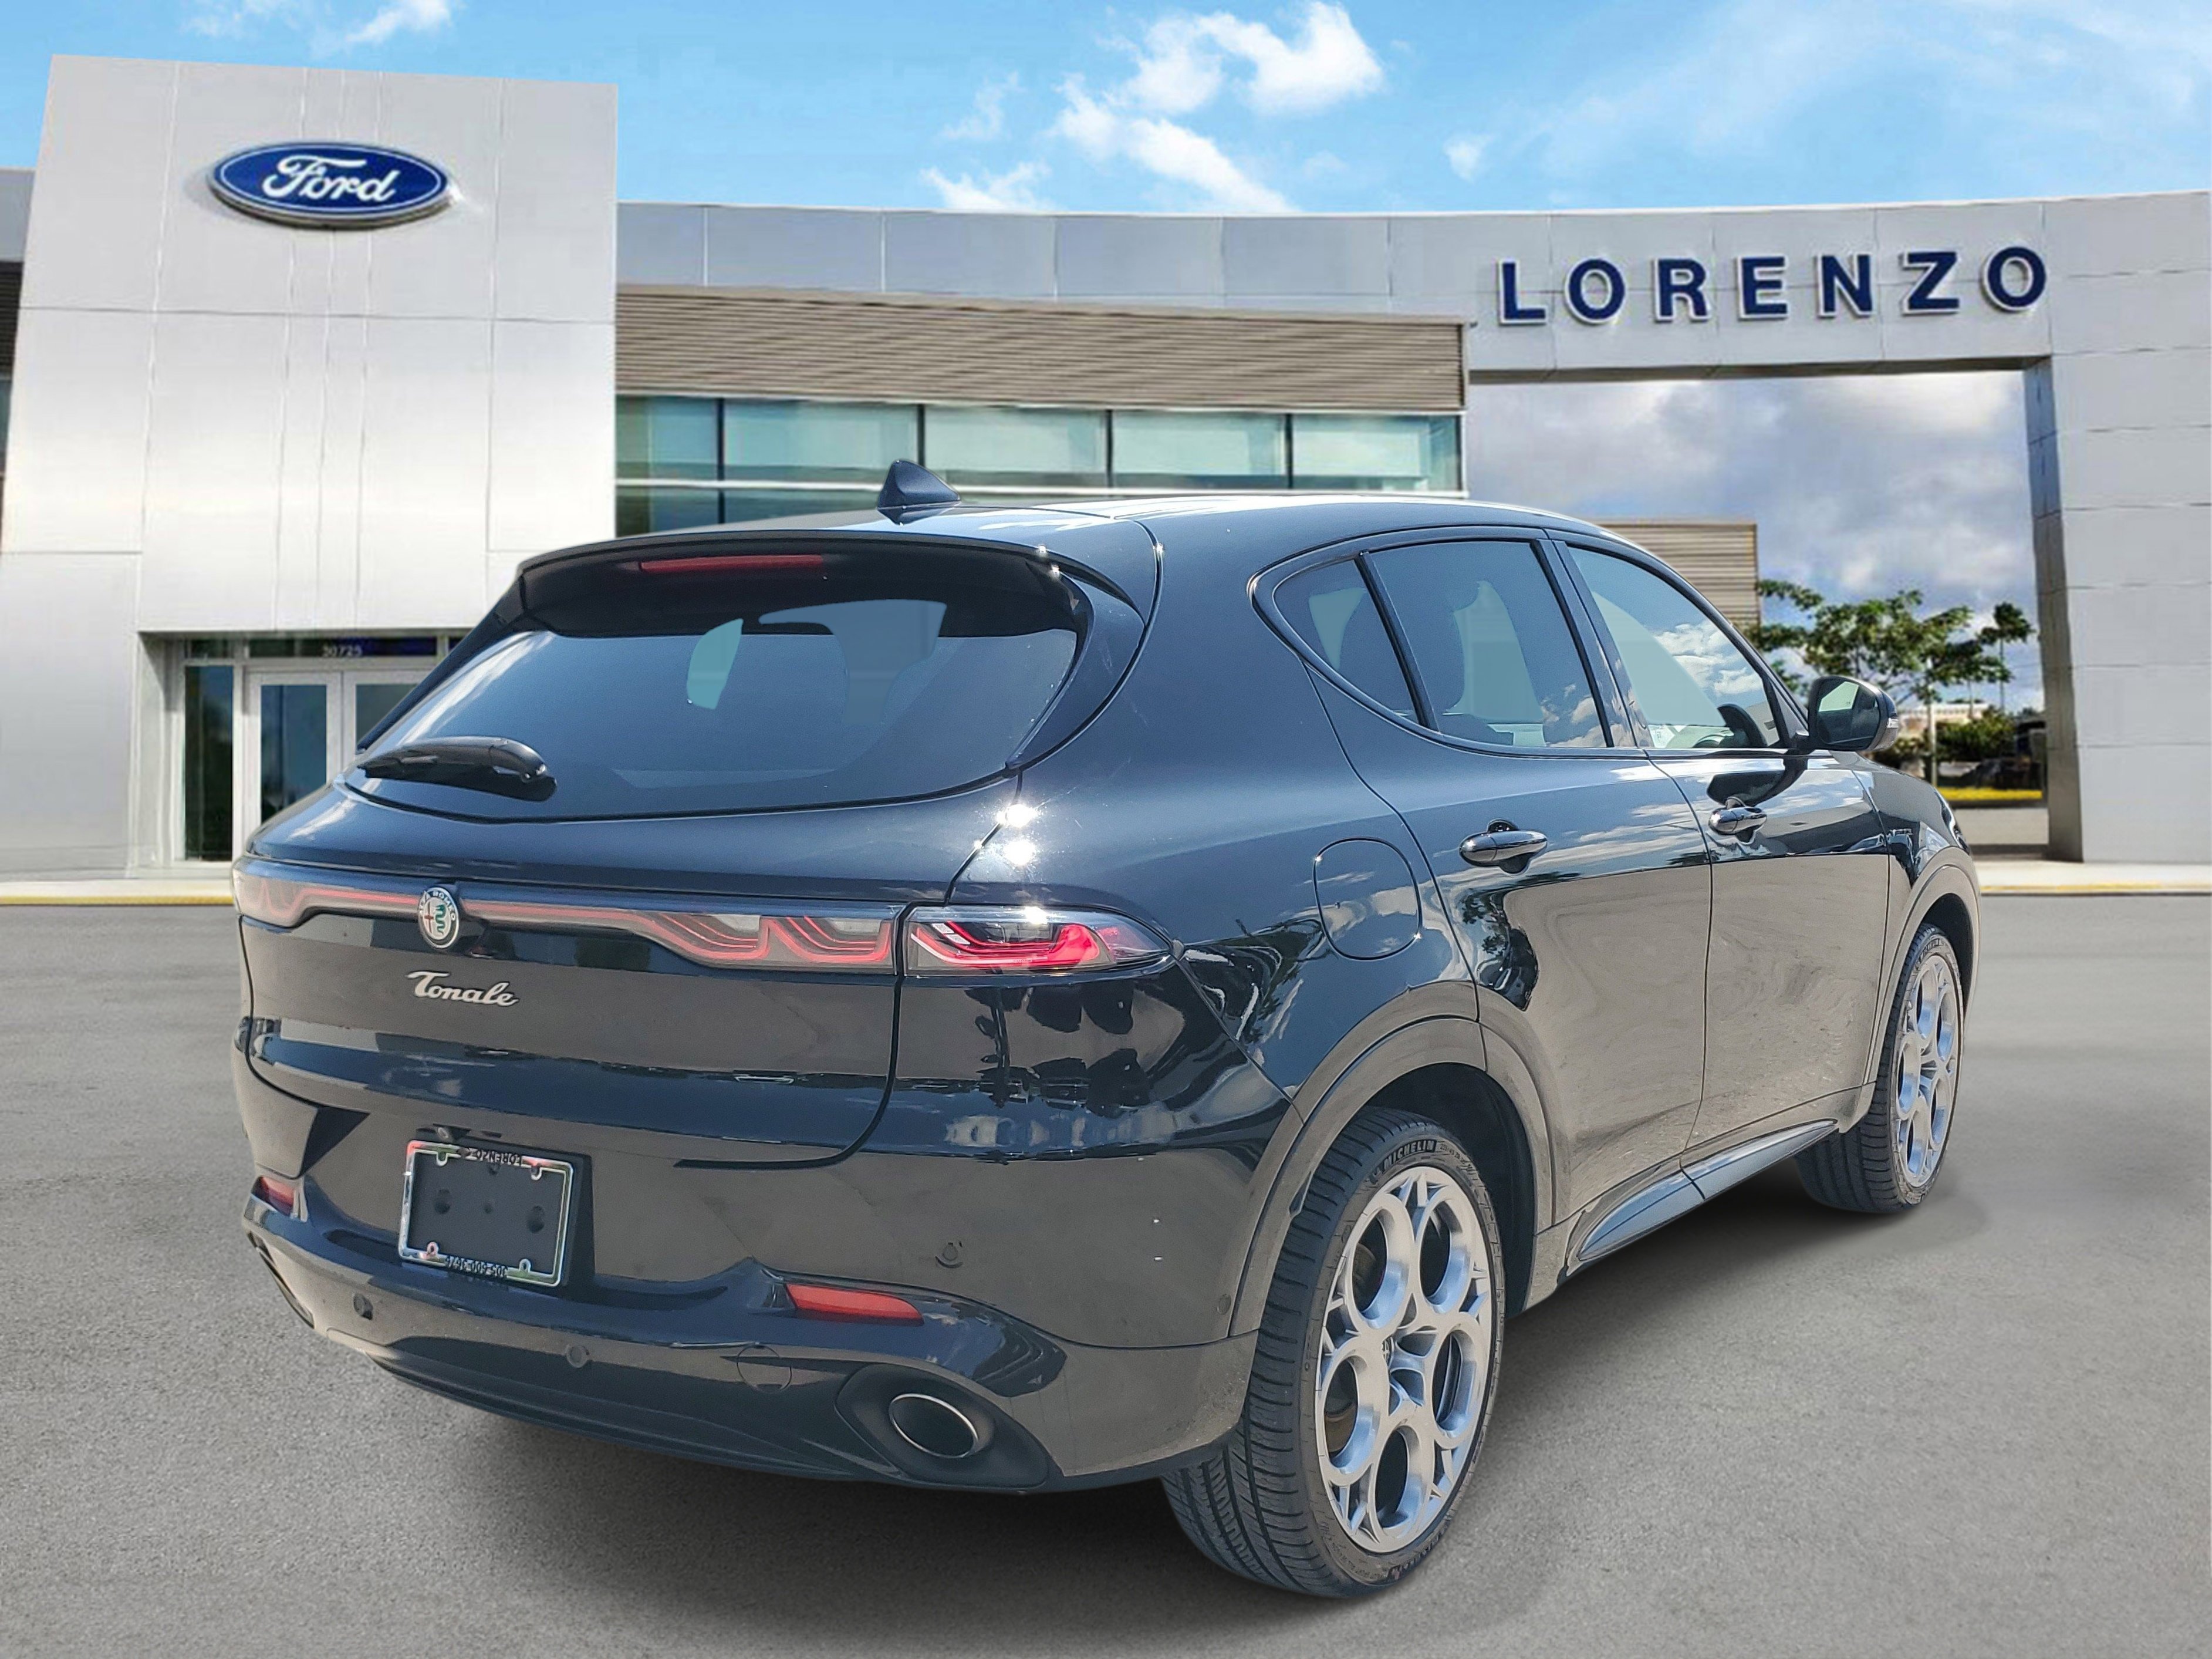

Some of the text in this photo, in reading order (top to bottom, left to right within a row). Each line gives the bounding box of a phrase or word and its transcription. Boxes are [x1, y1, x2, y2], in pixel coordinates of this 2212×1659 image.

[262, 154, 400, 202] Ford
[1498, 246, 2048, 325] LORENZO
[406, 970, 520, 1007] Tonale
[1382, 1139, 1436, 1172] MICHELIN
